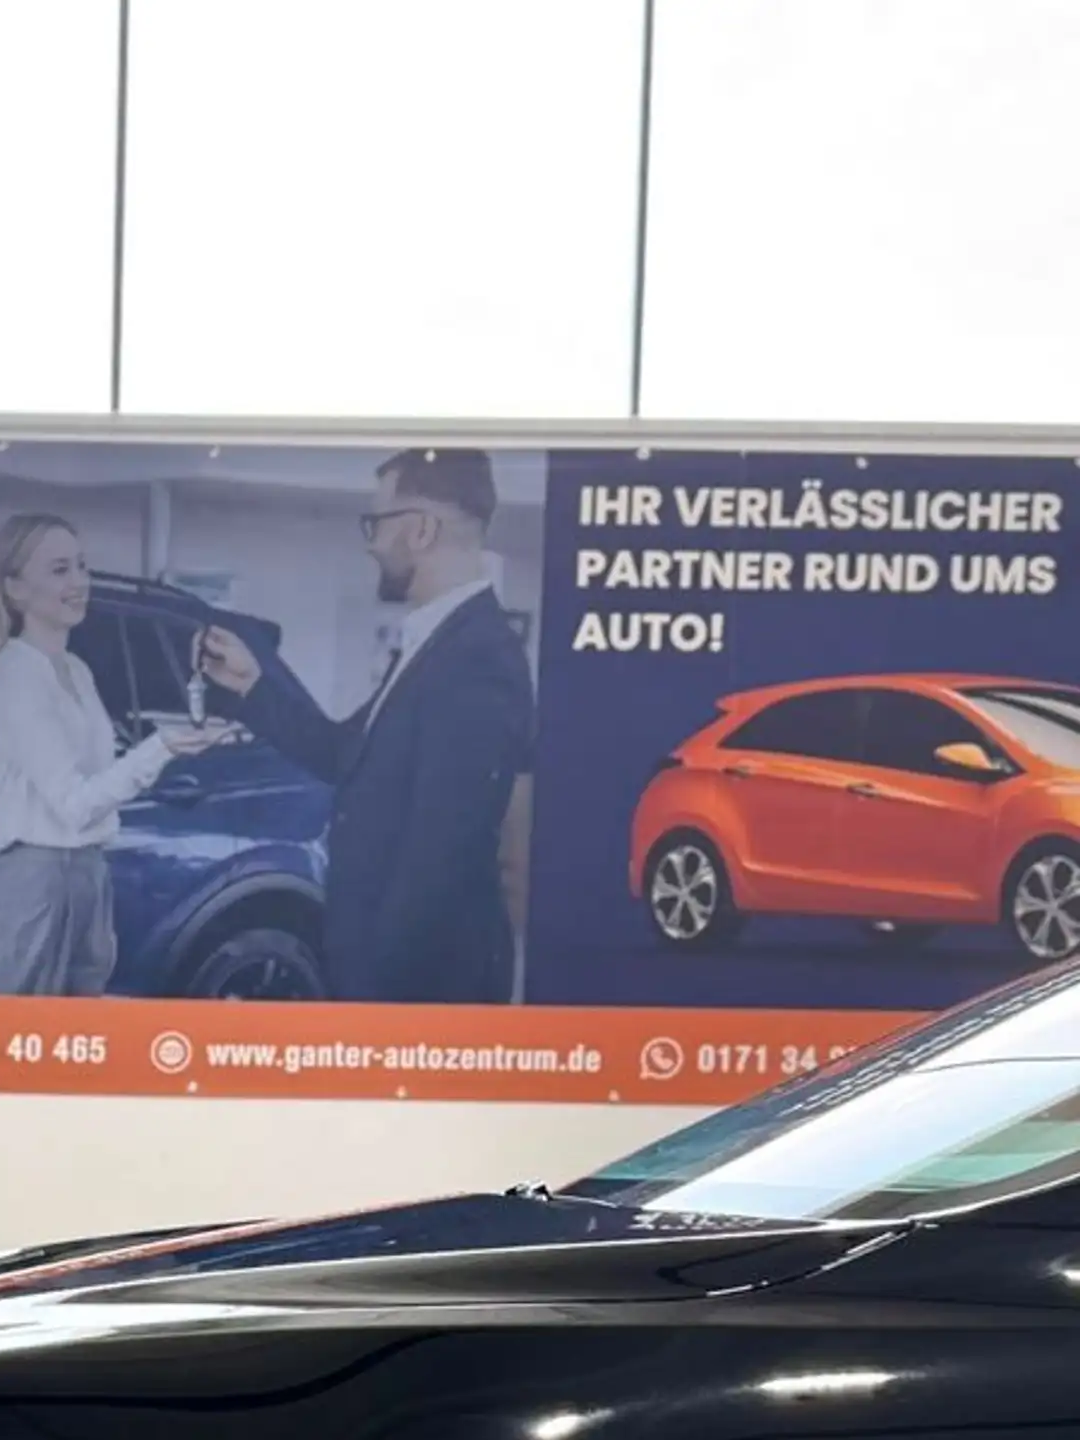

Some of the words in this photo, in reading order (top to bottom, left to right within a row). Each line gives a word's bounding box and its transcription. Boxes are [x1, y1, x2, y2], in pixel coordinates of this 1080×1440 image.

[579, 485, 661, 526] IHR
[674, 479, 1062, 532] VERLÄSSLICHER
[576, 550, 793, 590] PARTNER
[804, 553, 938, 592] RUND
[950, 555, 1057, 594] UMS
[572, 612, 724, 652] AUTO!
[6, 1034, 42, 1062] 40
[53, 1035, 106, 1063] 465
[206, 1042, 602, 1074] www.ganter-autozentrum.de
[697, 1044, 769, 1074] 0171
[781, 1046, 818, 1074] 34
